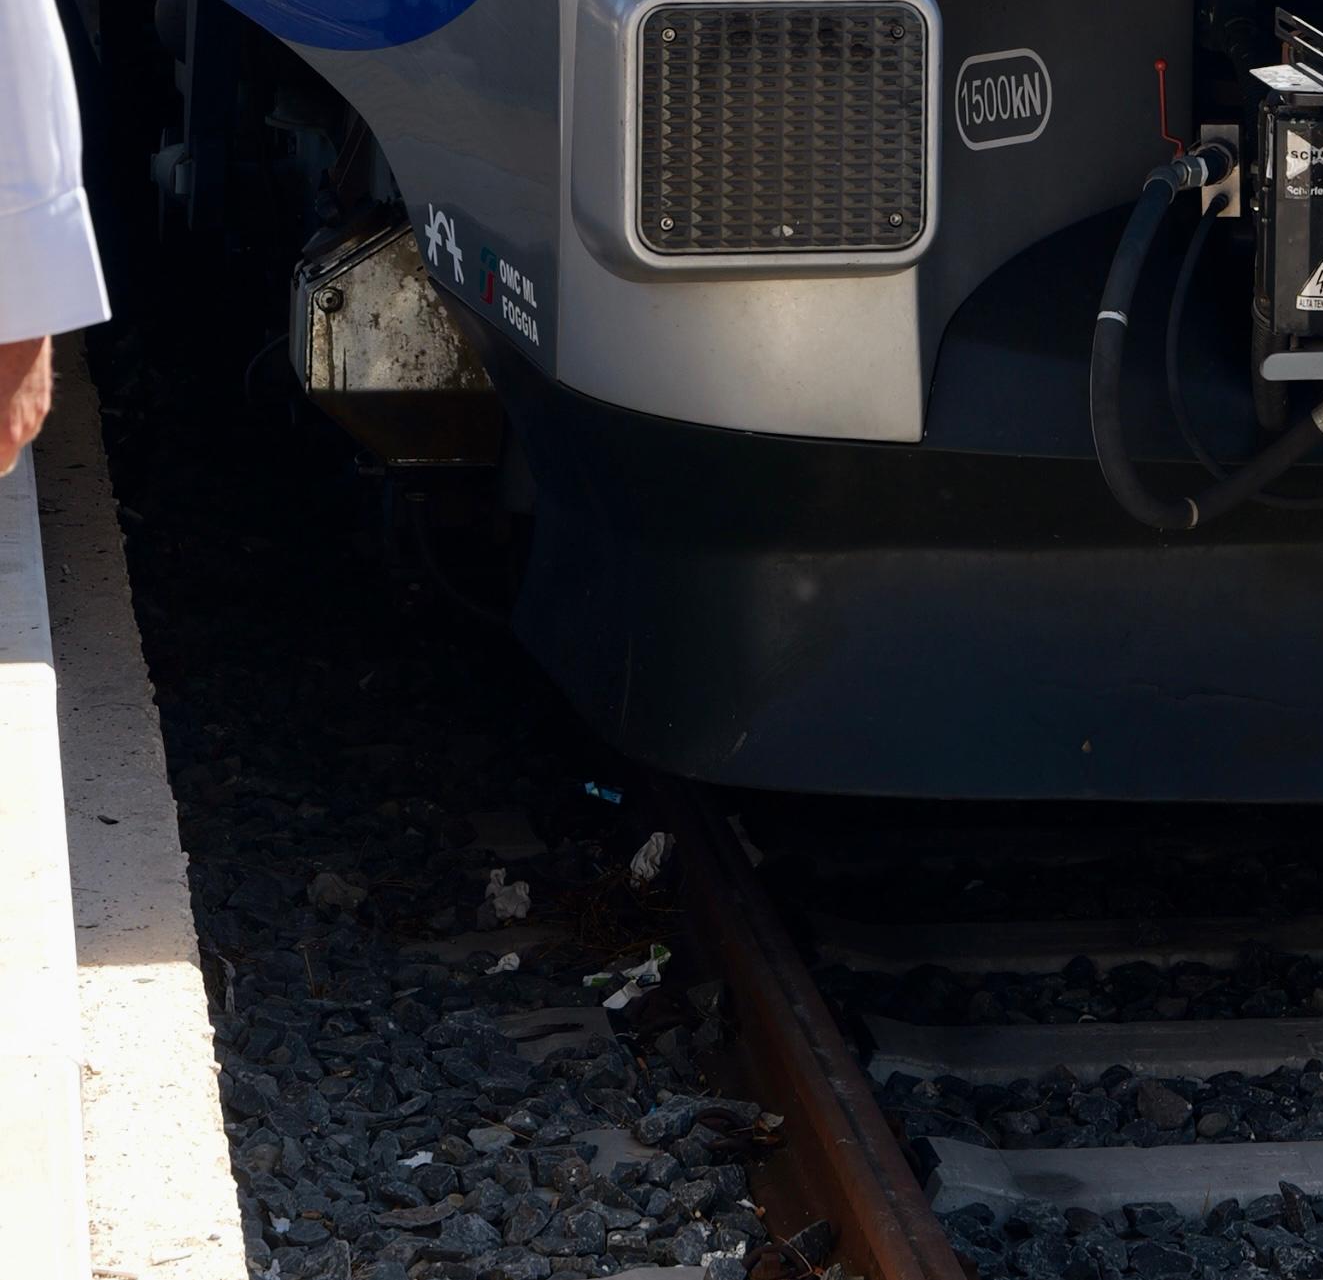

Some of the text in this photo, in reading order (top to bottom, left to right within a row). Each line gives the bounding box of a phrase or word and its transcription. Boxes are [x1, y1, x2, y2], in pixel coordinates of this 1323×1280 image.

[960, 70, 1042, 127] 1500kN
[499, 259, 537, 309] OMC ML
[502, 295, 540, 346] FOGGIA
